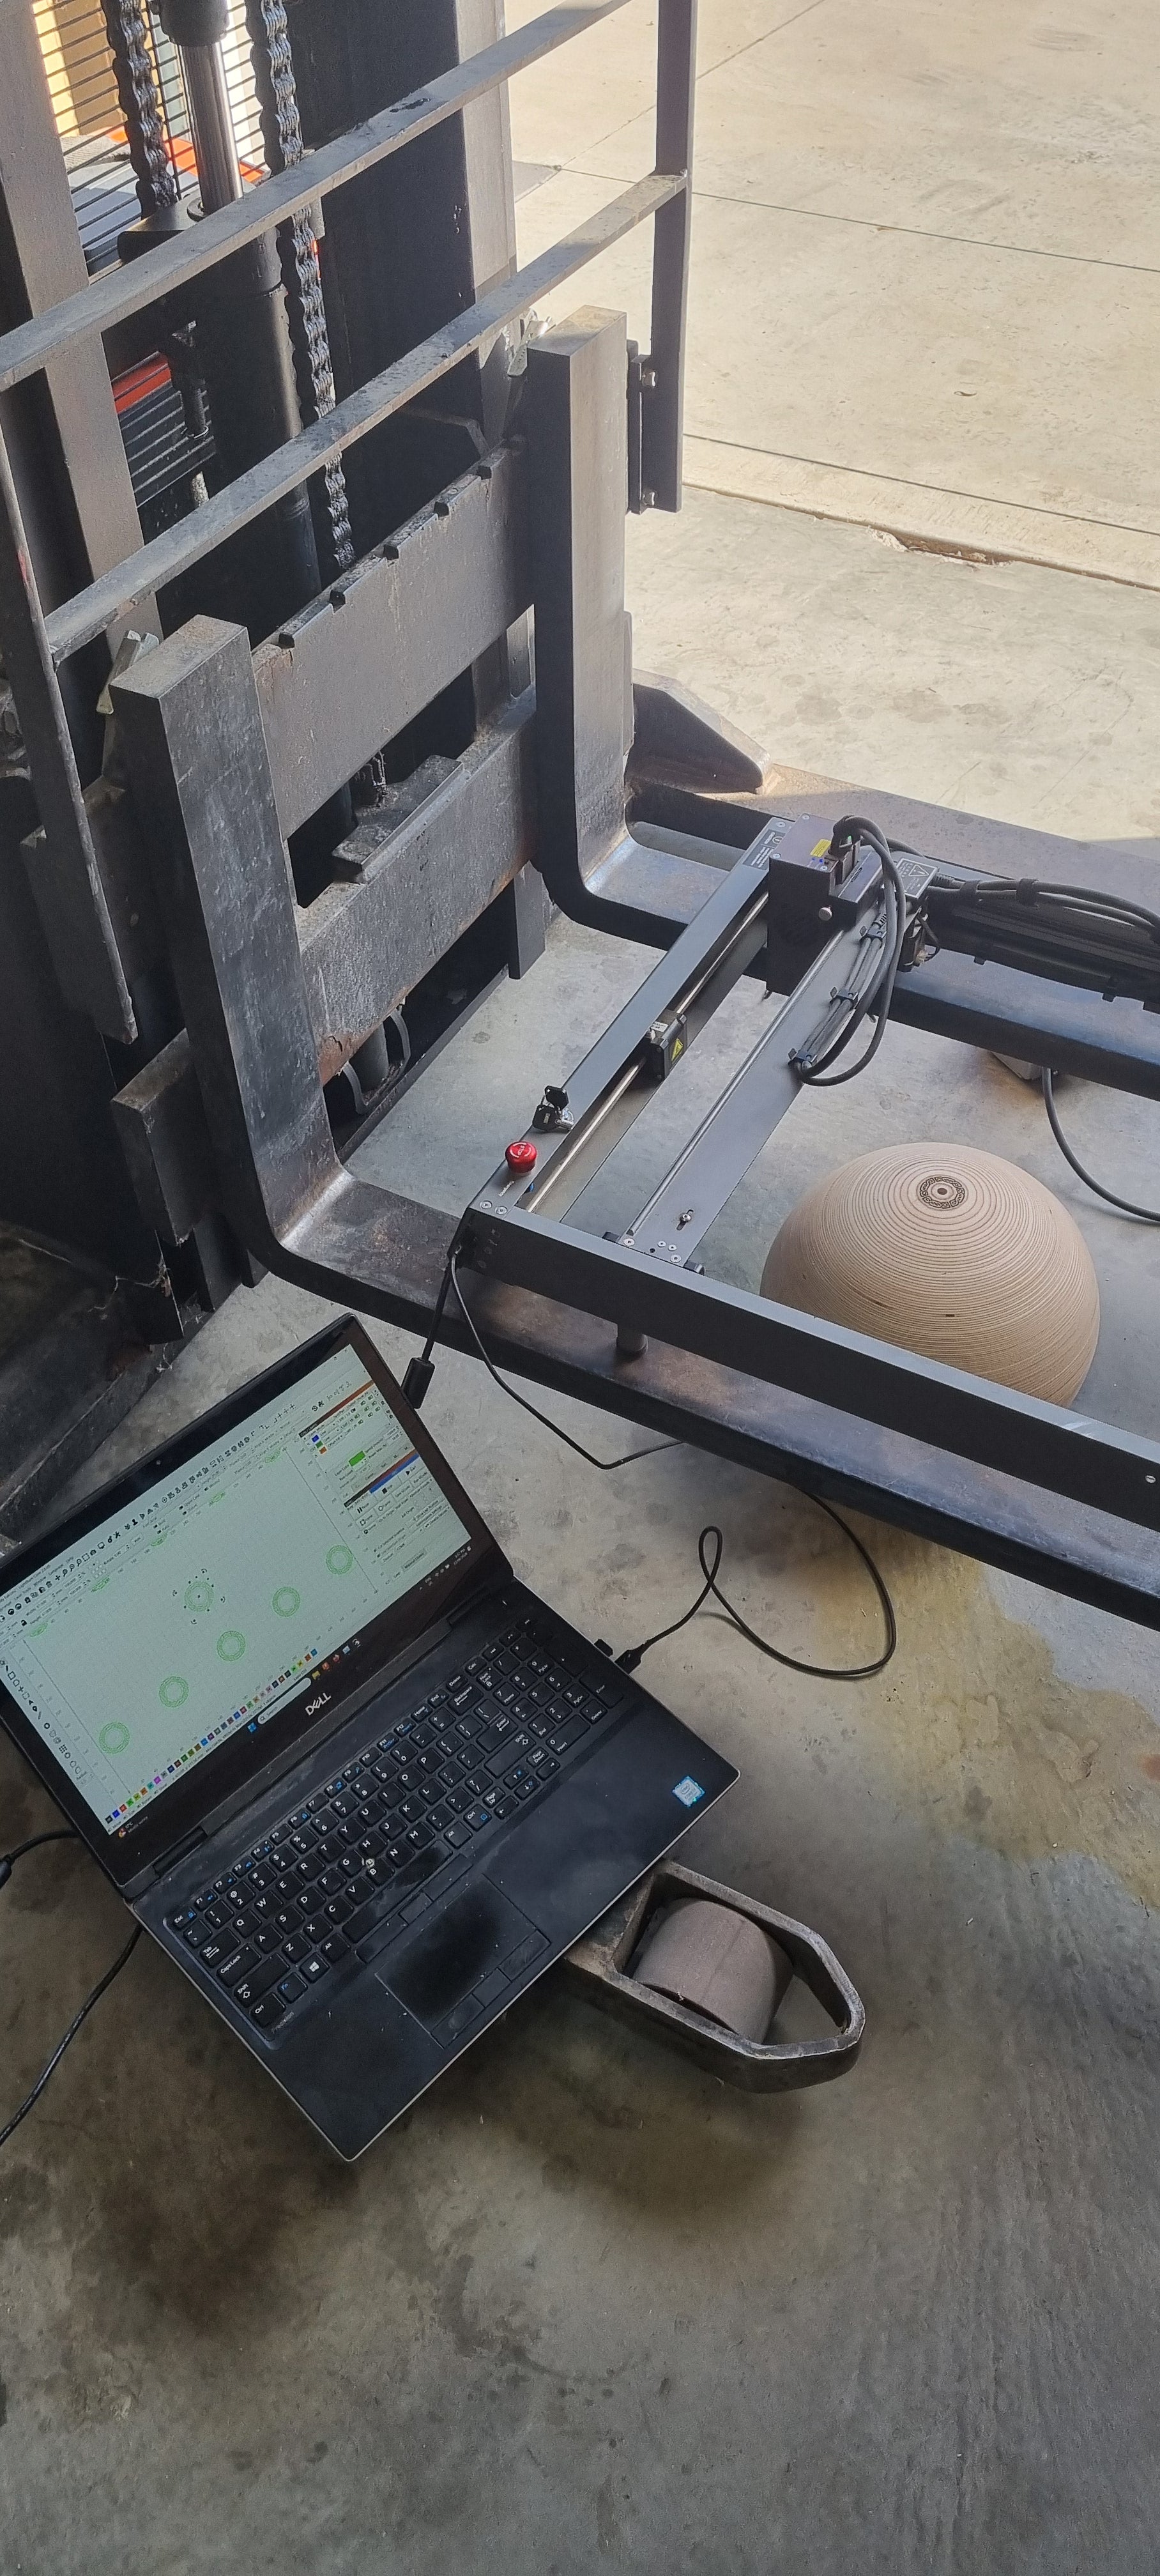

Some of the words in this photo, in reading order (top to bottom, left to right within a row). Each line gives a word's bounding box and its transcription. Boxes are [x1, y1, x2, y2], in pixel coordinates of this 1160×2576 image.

[448, 1676, 461, 1687] Delete
[431, 1694, 439, 1702] End
[305, 1692, 332, 1716] DELL
[591, 1710, 602, 1720] Delete
[257, 1897, 266, 1906] W
[231, 1955, 241, 1965] Lock
[256, 2005, 264, 2014] Ctrl
[271, 2011, 294, 2034] Precision
